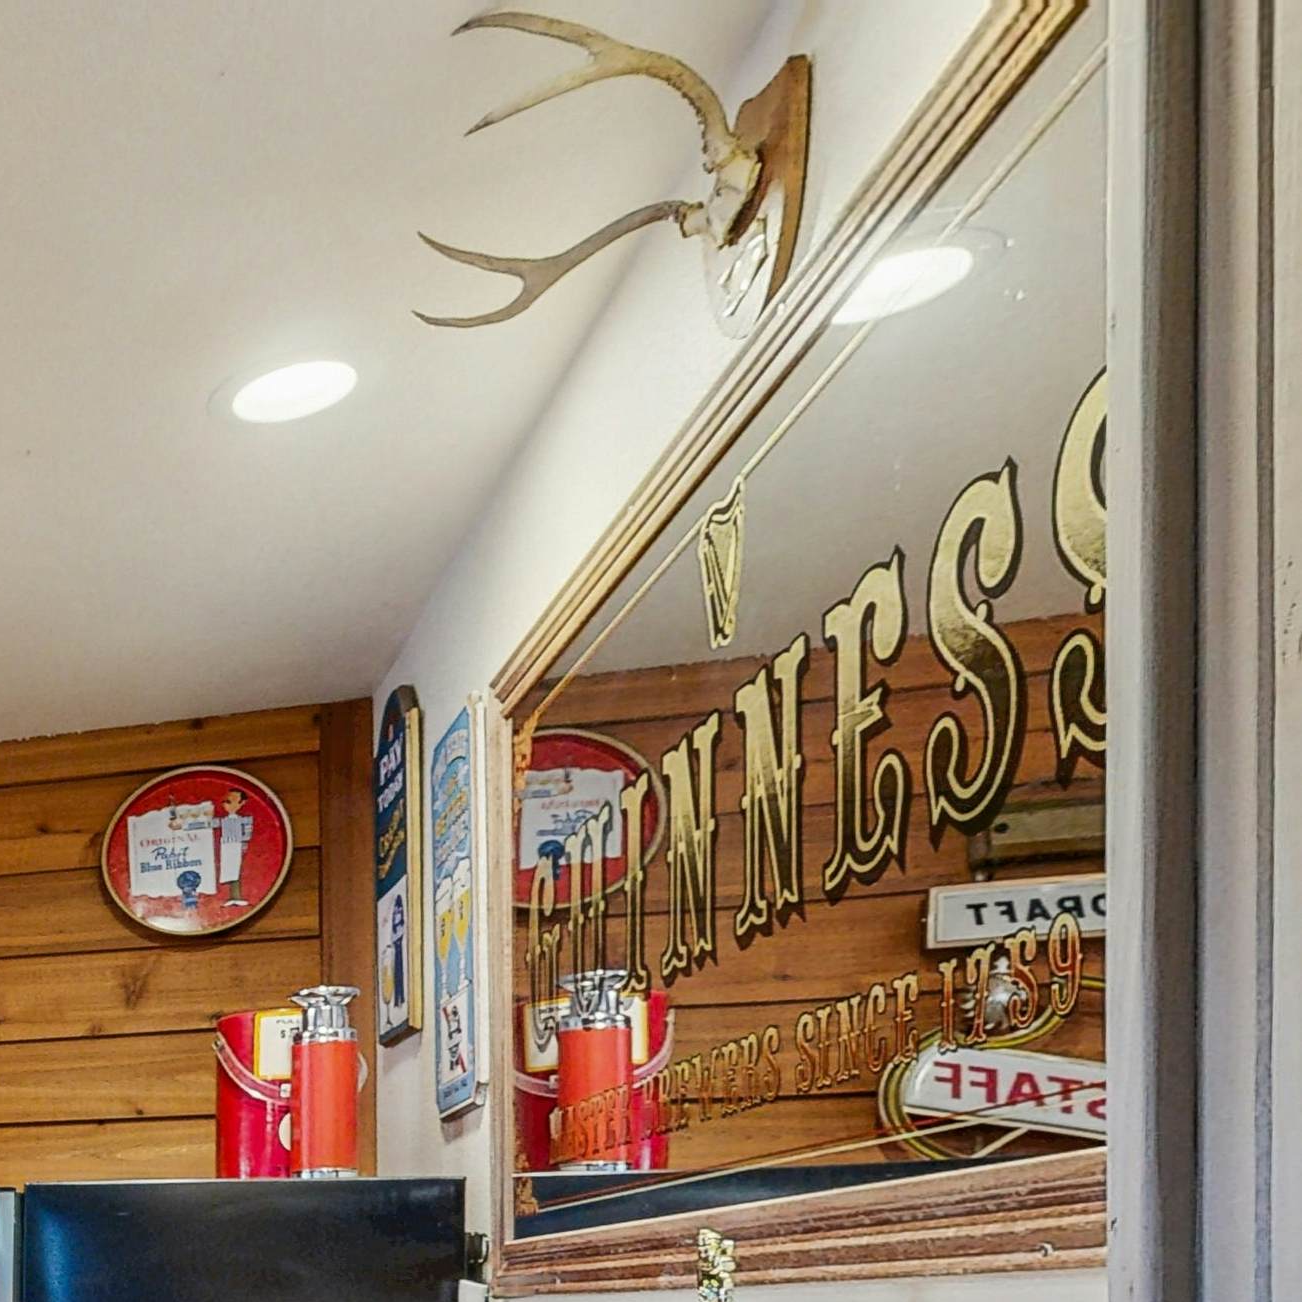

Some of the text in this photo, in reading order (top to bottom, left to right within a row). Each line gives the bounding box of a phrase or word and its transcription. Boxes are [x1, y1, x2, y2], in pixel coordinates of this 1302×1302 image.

[140, 859, 202, 873] Blue Ribbon
[640, 1024, 780, 1140] BREWERS
[795, 970, 919, 1092] SINCE
[939, 911, 1082, 1054] 1759
